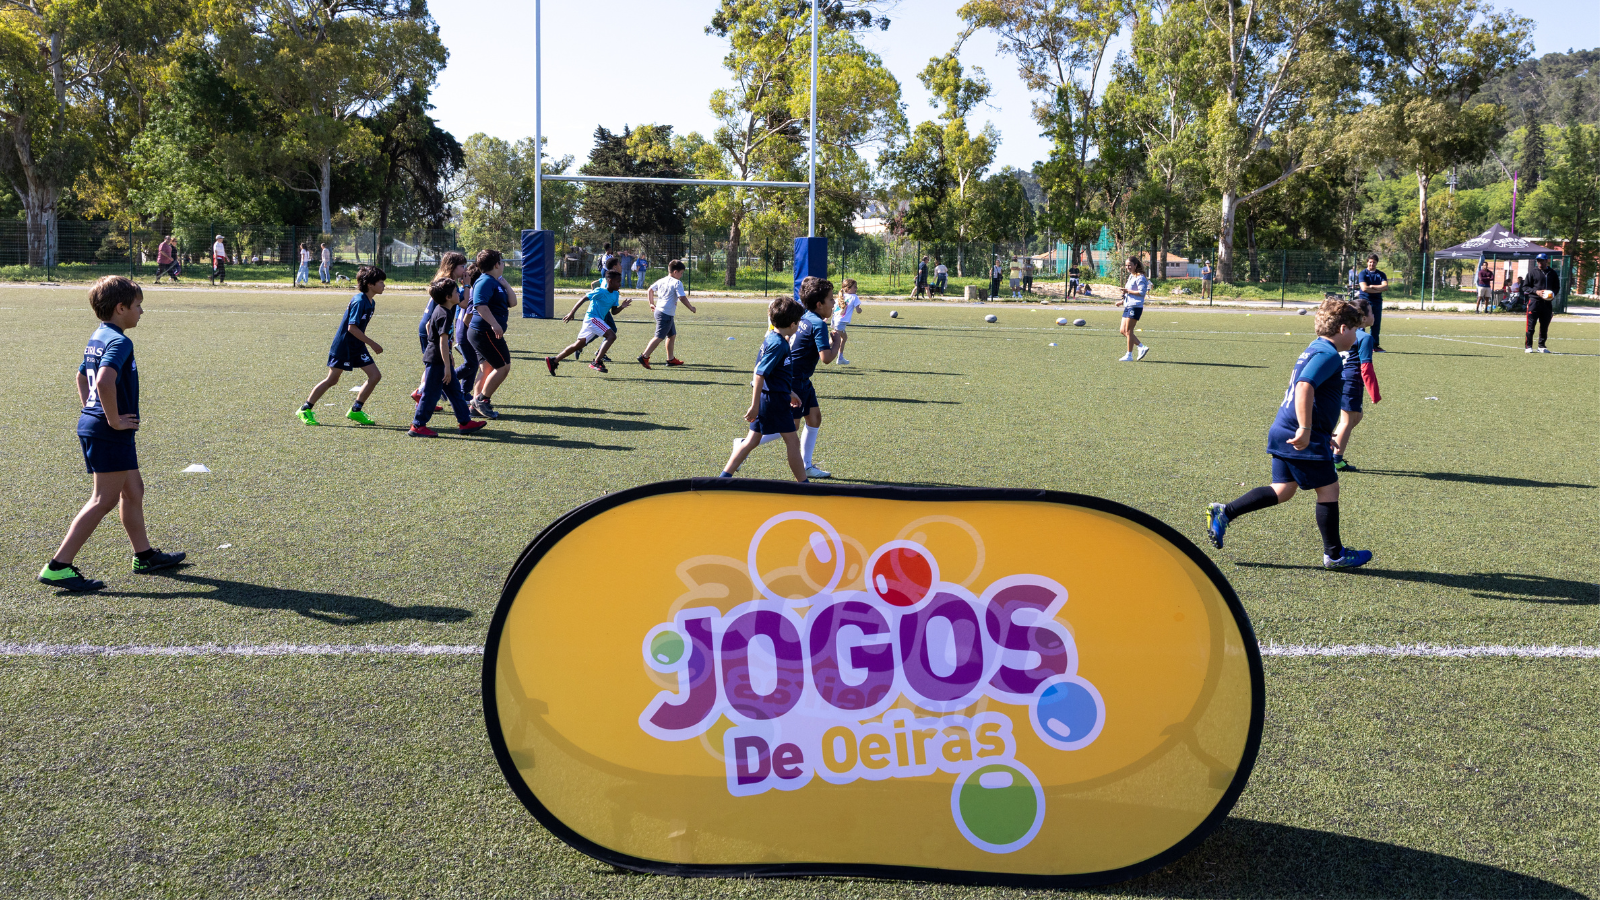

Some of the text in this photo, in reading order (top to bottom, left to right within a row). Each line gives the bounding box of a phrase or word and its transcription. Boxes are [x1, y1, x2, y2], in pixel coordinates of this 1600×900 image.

[649, 584, 1069, 731] JOGOS
[733, 719, 1007, 786] De Oeiras
